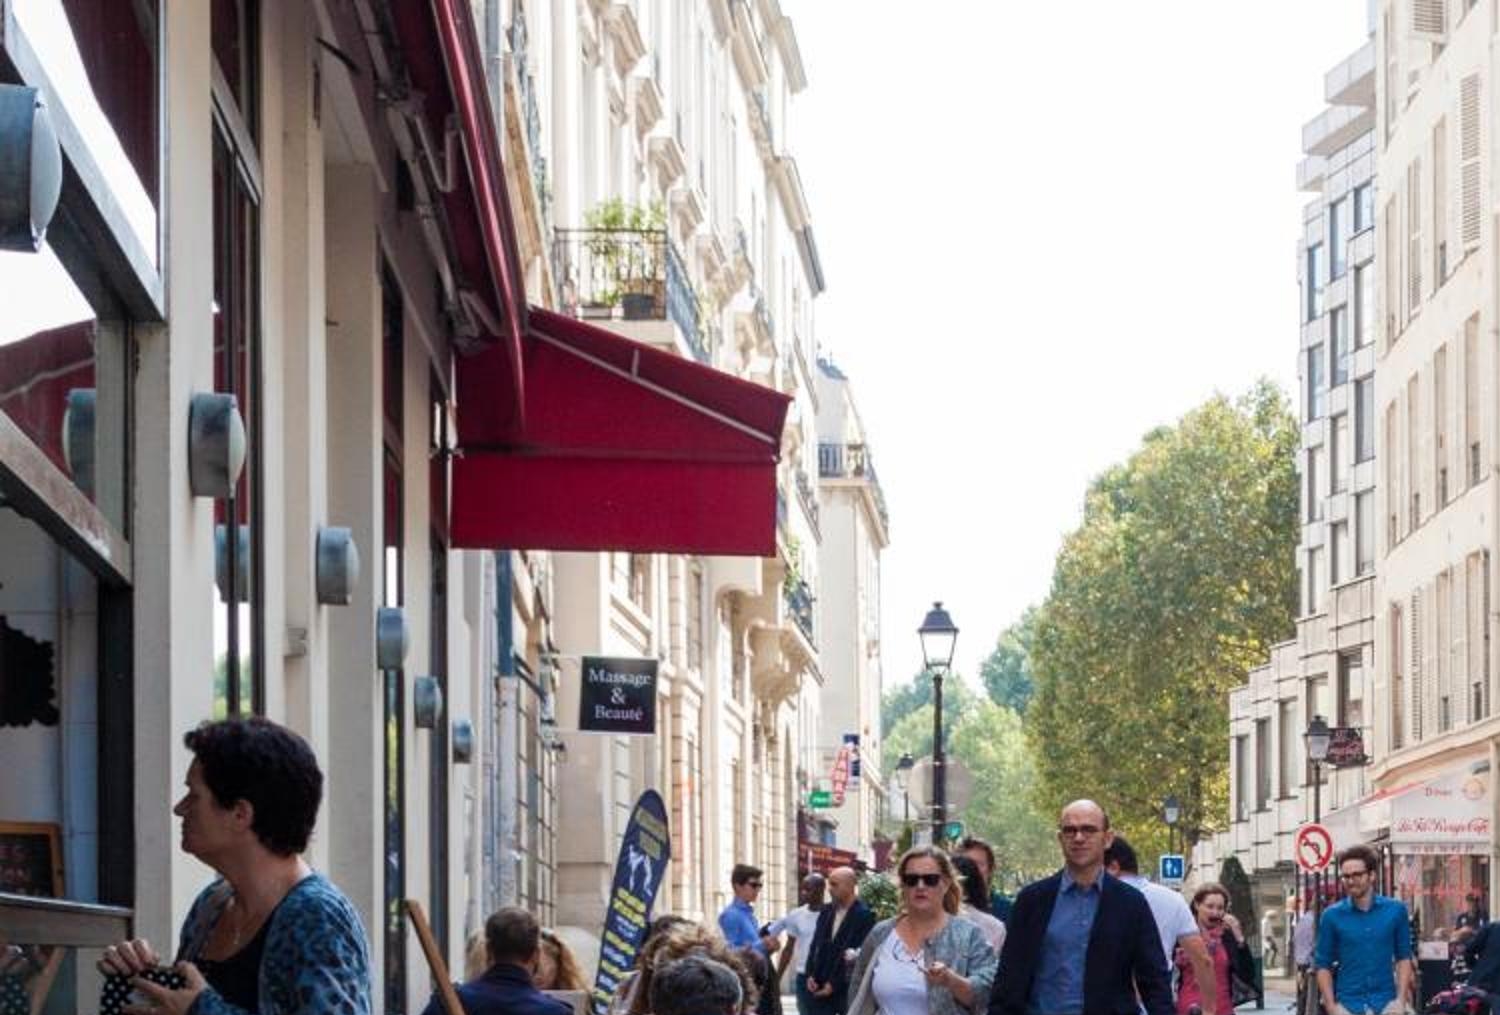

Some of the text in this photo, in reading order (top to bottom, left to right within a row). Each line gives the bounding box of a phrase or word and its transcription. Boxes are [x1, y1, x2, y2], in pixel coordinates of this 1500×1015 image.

[588, 667, 651, 688] Massage
[611, 687, 625, 704] &
[594, 704, 643, 721] Beauté
